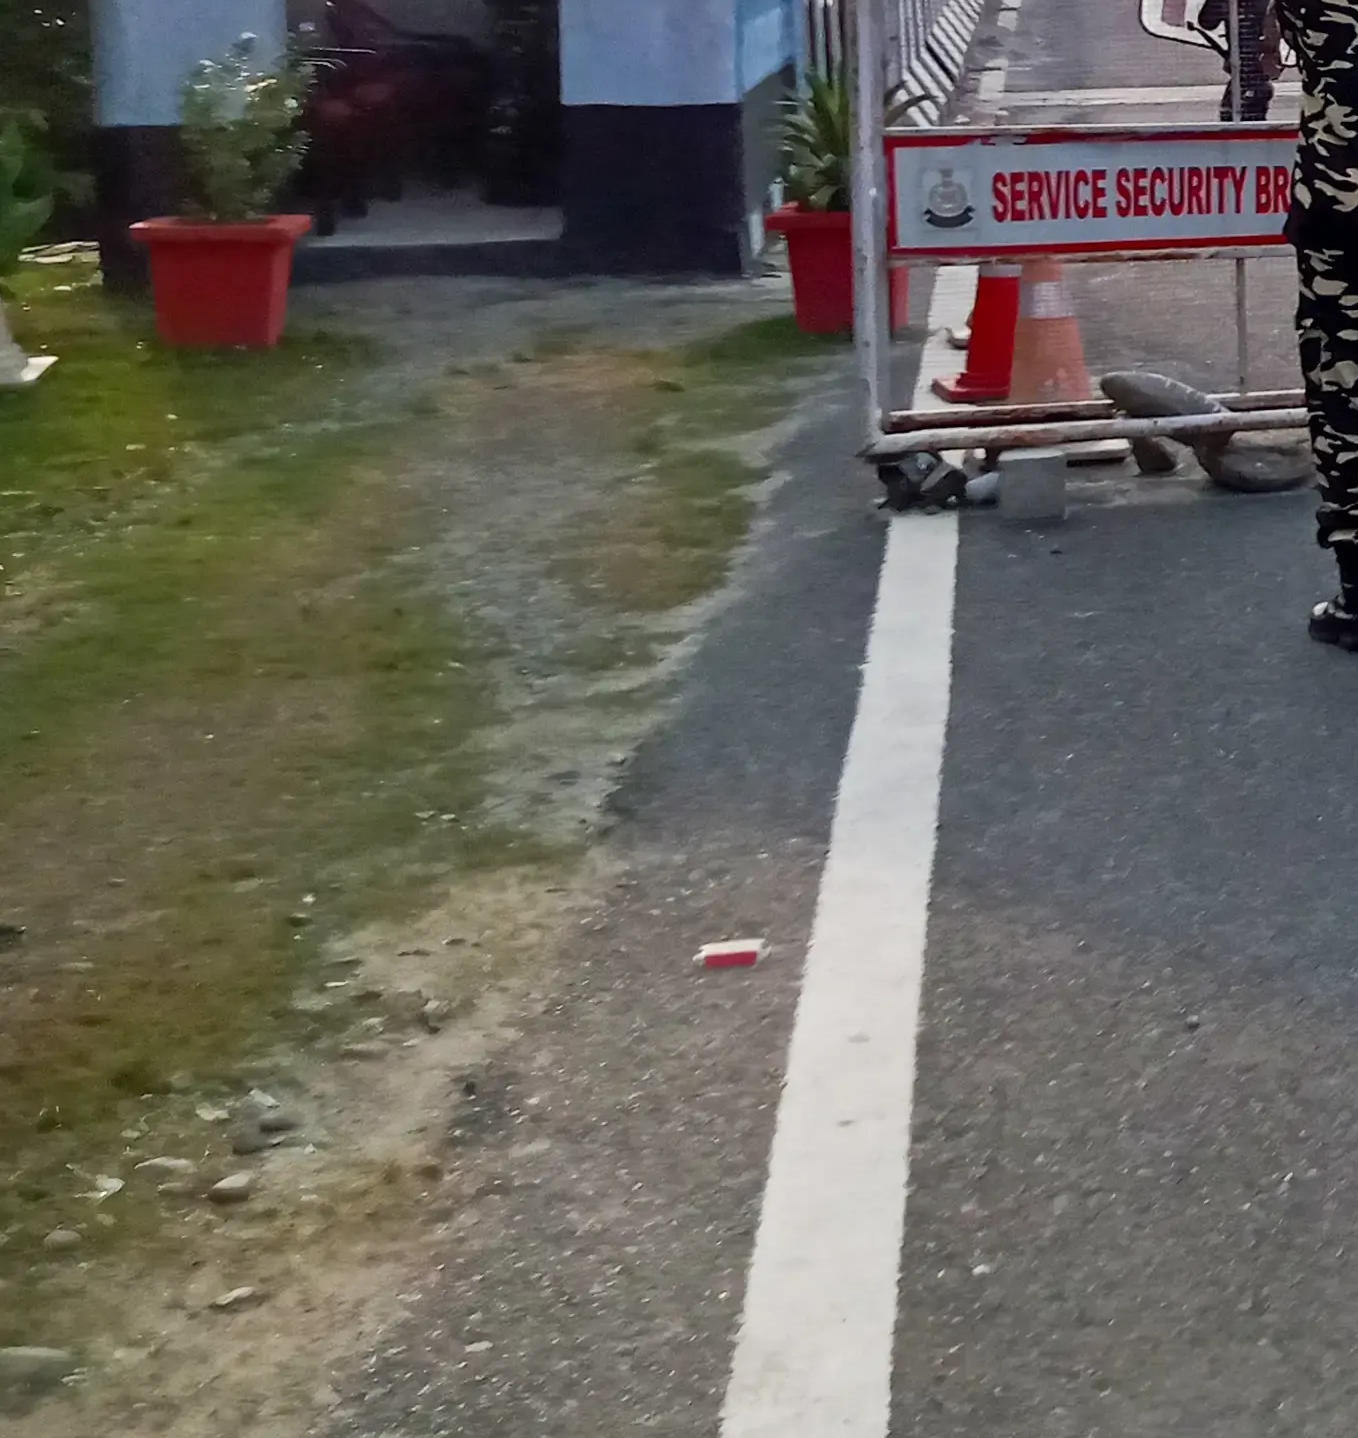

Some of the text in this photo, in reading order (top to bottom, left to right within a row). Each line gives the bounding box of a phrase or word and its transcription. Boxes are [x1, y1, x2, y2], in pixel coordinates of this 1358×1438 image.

[992, 165, 1291, 222] SERVICE SECURITY BR
